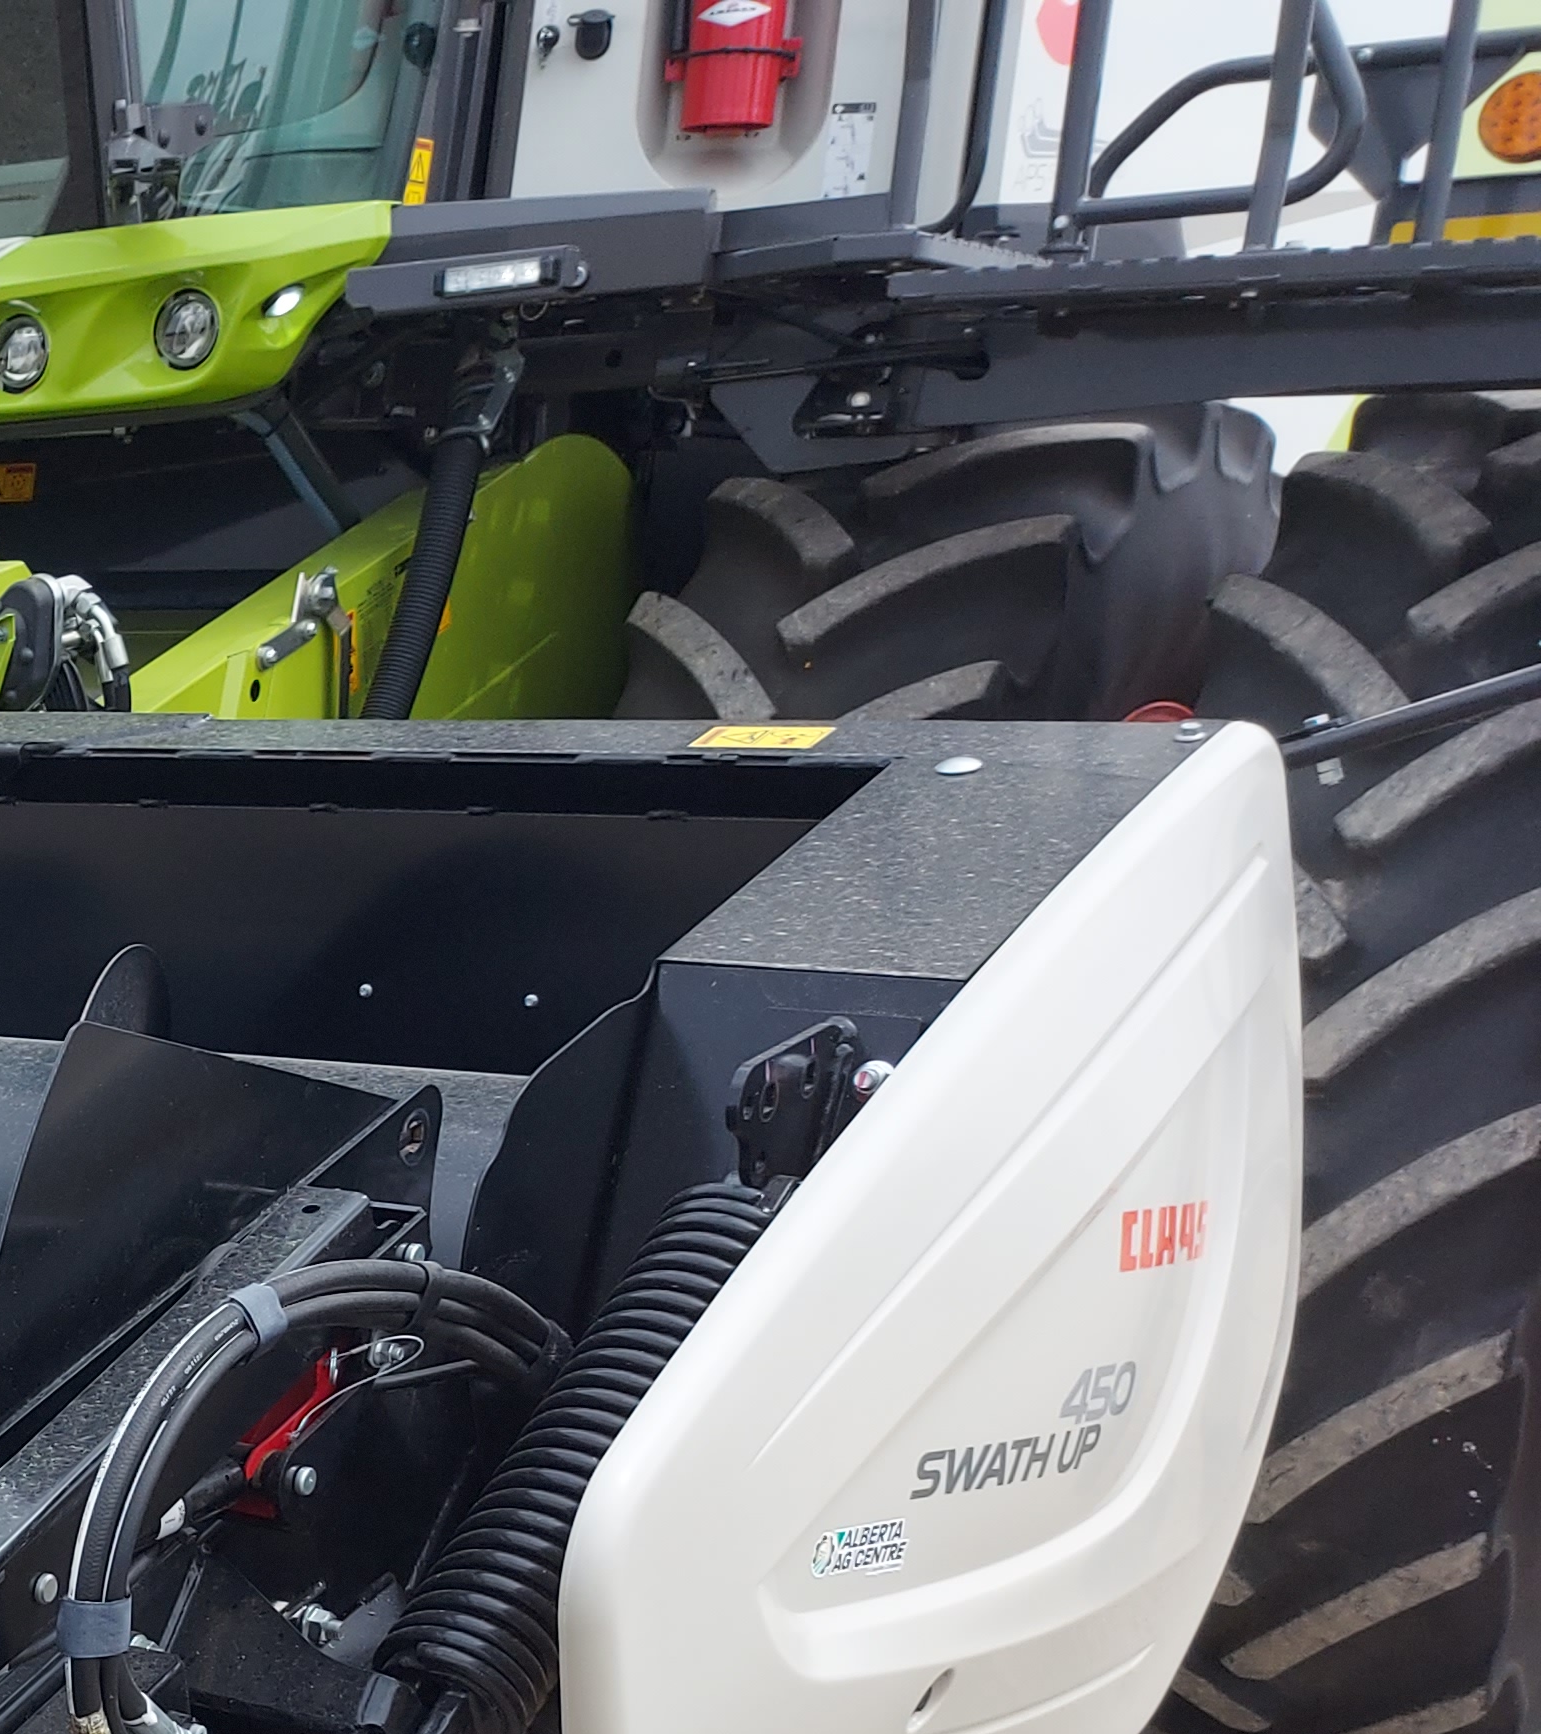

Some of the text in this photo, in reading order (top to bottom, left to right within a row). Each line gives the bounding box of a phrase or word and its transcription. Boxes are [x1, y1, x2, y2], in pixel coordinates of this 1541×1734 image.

[1119, 1200, 1208, 1272] CLAAS
[1058, 1361, 1136, 1424] 450
[909, 1423, 1101, 1500] SWATH UP
[831, 1541, 907, 1573] AG CENTRE
[841, 1520, 904, 1550] ALBERTA
